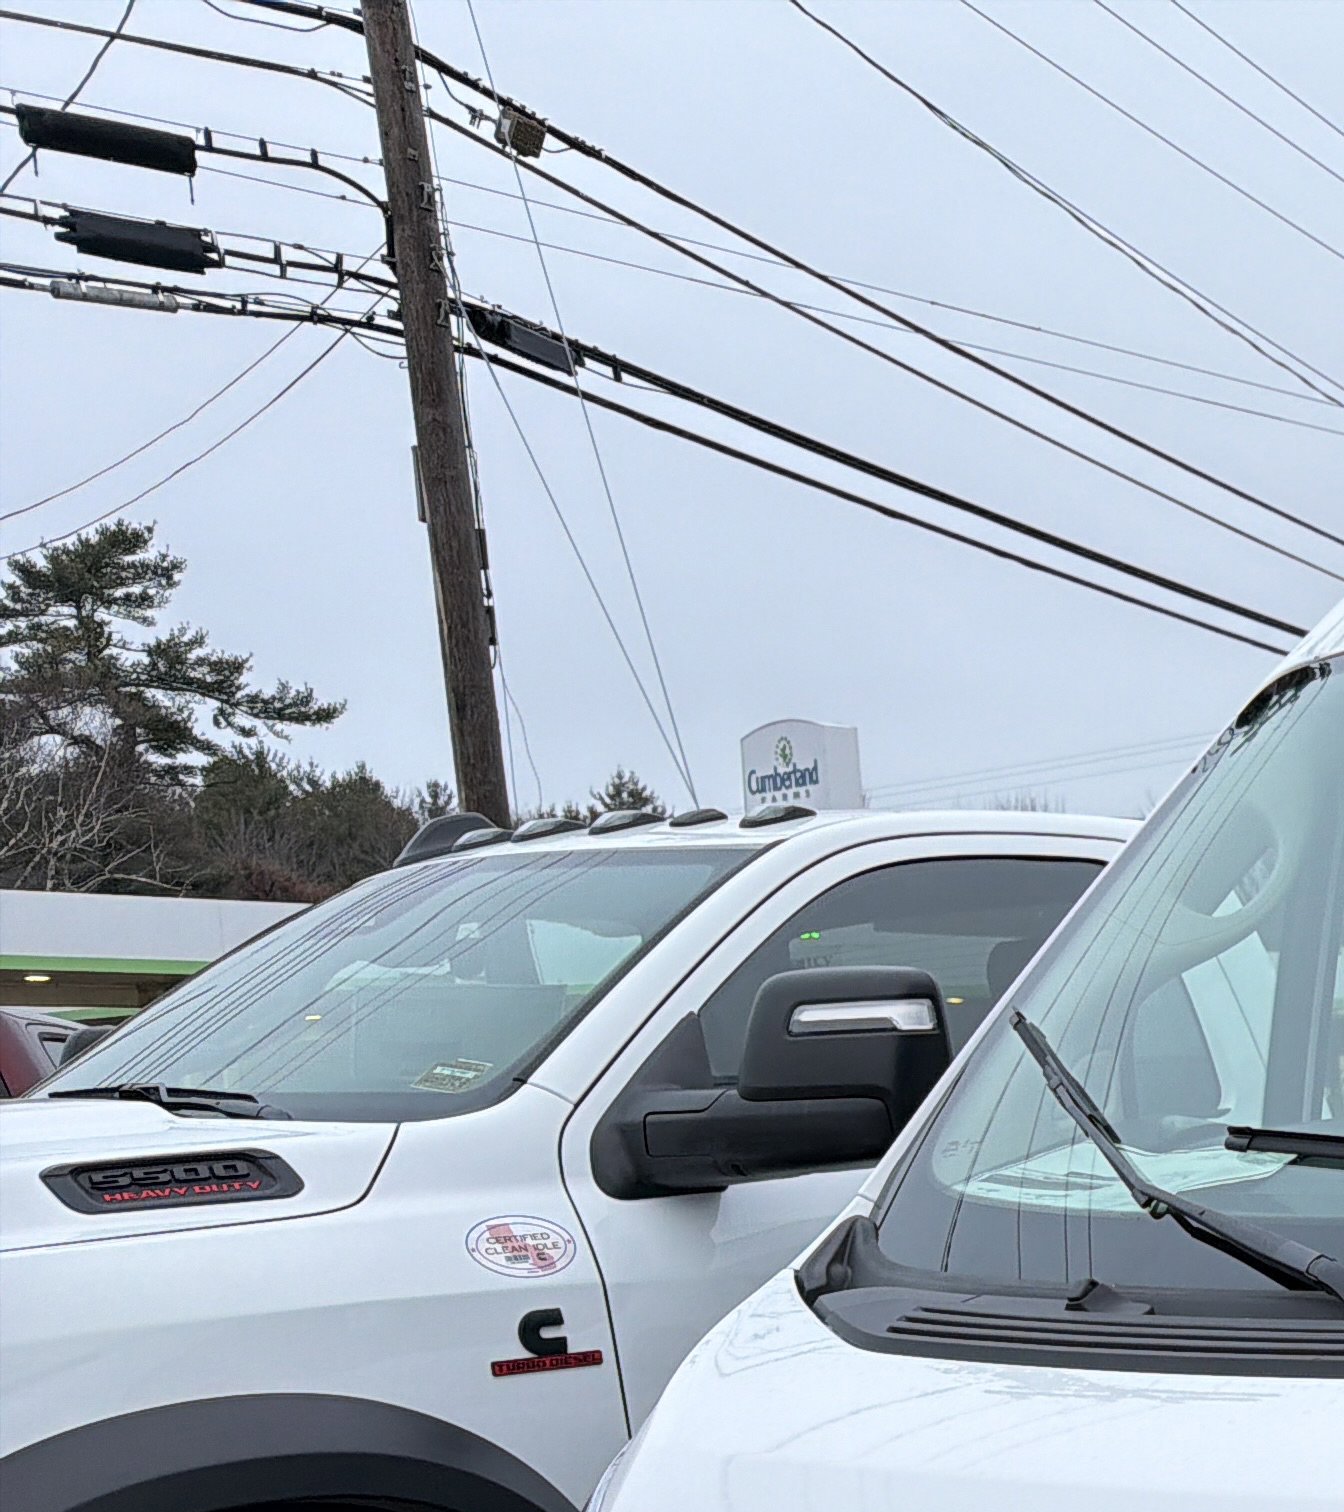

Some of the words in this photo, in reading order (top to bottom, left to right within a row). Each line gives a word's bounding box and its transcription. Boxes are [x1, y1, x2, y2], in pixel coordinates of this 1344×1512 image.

[747, 758, 819, 795] Cumberland
[89, 1159, 253, 1192] 5500
[103, 1186, 189, 1203] HEAVY
[194, 1179, 262, 1195] DUTY
[484, 1244, 529, 1256] CLEAN
[485, 1232, 550, 1245] CERTIFIED
